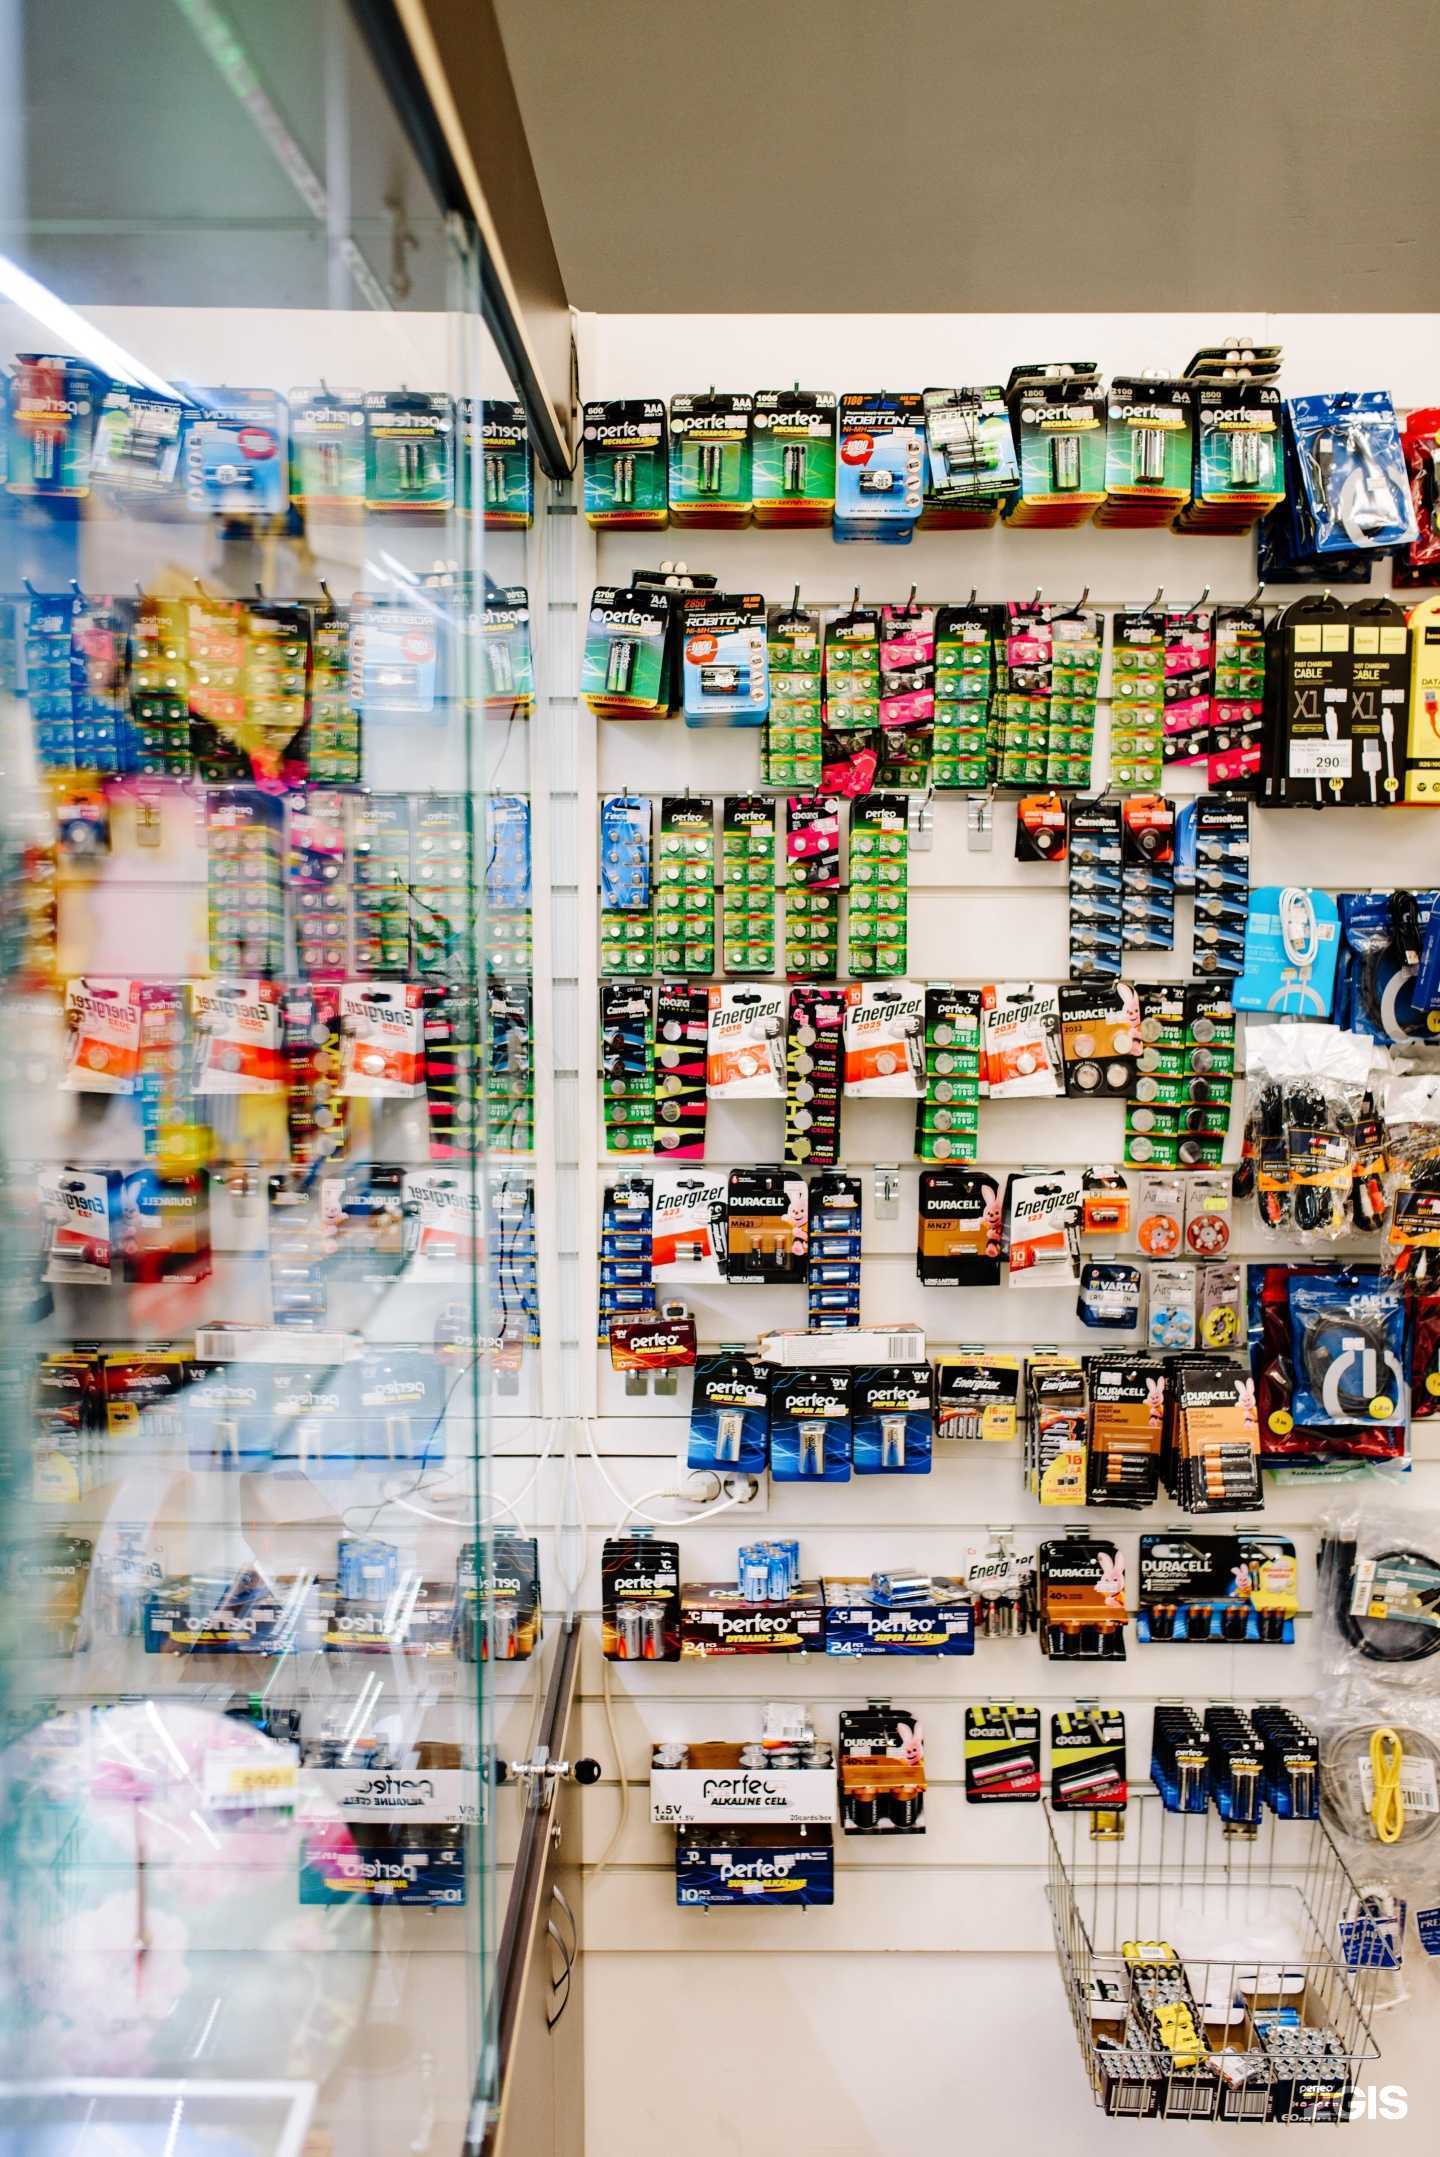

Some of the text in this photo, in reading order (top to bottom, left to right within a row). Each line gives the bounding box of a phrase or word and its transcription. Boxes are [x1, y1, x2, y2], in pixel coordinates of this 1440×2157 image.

[767, 410, 820, 428] perfeo
[843, 415, 906, 425] ROBITON
[602, 608, 651, 624] perfeo
[686, 615, 748, 626] ROBITON
[777, 623, 811, 634] perfeo
[949, 621, 981, 632] perfeo
[1225, 621, 1255, 631] perfeo
[1294, 668, 1323, 679] CABLE
[1293, 690, 1321, 719] X1
[1352, 691, 1378, 719] X1
[1316, 756, 1340, 768] 290
[671, 812, 704, 824] perfeo
[734, 811, 767, 822] perfeo
[865, 809, 897, 820] perfeo
[1201, 814, 1244, 823] Camelion
[1074, 817, 1117, 828] Camelion
[711, 1000, 782, 1029] Energizer
[851, 999, 922, 1025] Energizer
[937, 1004, 974, 1015] perfeo
[988, 999, 1055, 1028] Energizer
[656, 1186, 724, 1210] Energizer
[730, 1196, 784, 1207] DURACELL
[927, 1200, 981, 1210] DURACELL
[1014, 1191, 1080, 1218] Energizer
[1100, 1281, 1138, 1292] VARTA
[630, 1333, 677, 1350] perfeo
[706, 1380, 755, 1395] perfeo
[952, 1377, 1001, 1391] Energizer
[1040, 1379, 1081, 1392] Energizer
[867, 1387, 917, 1403] perfeo
[1097, 1387, 1145, 1397] DURACELL
[1186, 1391, 1237, 1401] DURACELL
[785, 1393, 835, 1408] perfeo
[1142, 1560, 1212, 1572] DURACELL
[1050, 1568, 1102, 1577] DURACELL
[718, 1612, 789, 1636] perfeo
[874, 1634, 905, 1642] SUPER
[684, 1642, 705, 1653] 24
[831, 1642, 852, 1653] 24
[711, 1797, 788, 1806] ALKALINE CELL
[654, 1805, 682, 1814] 1.5V
[720, 1858, 789, 1882] perfeo
[681, 1888, 698, 1902] 10
